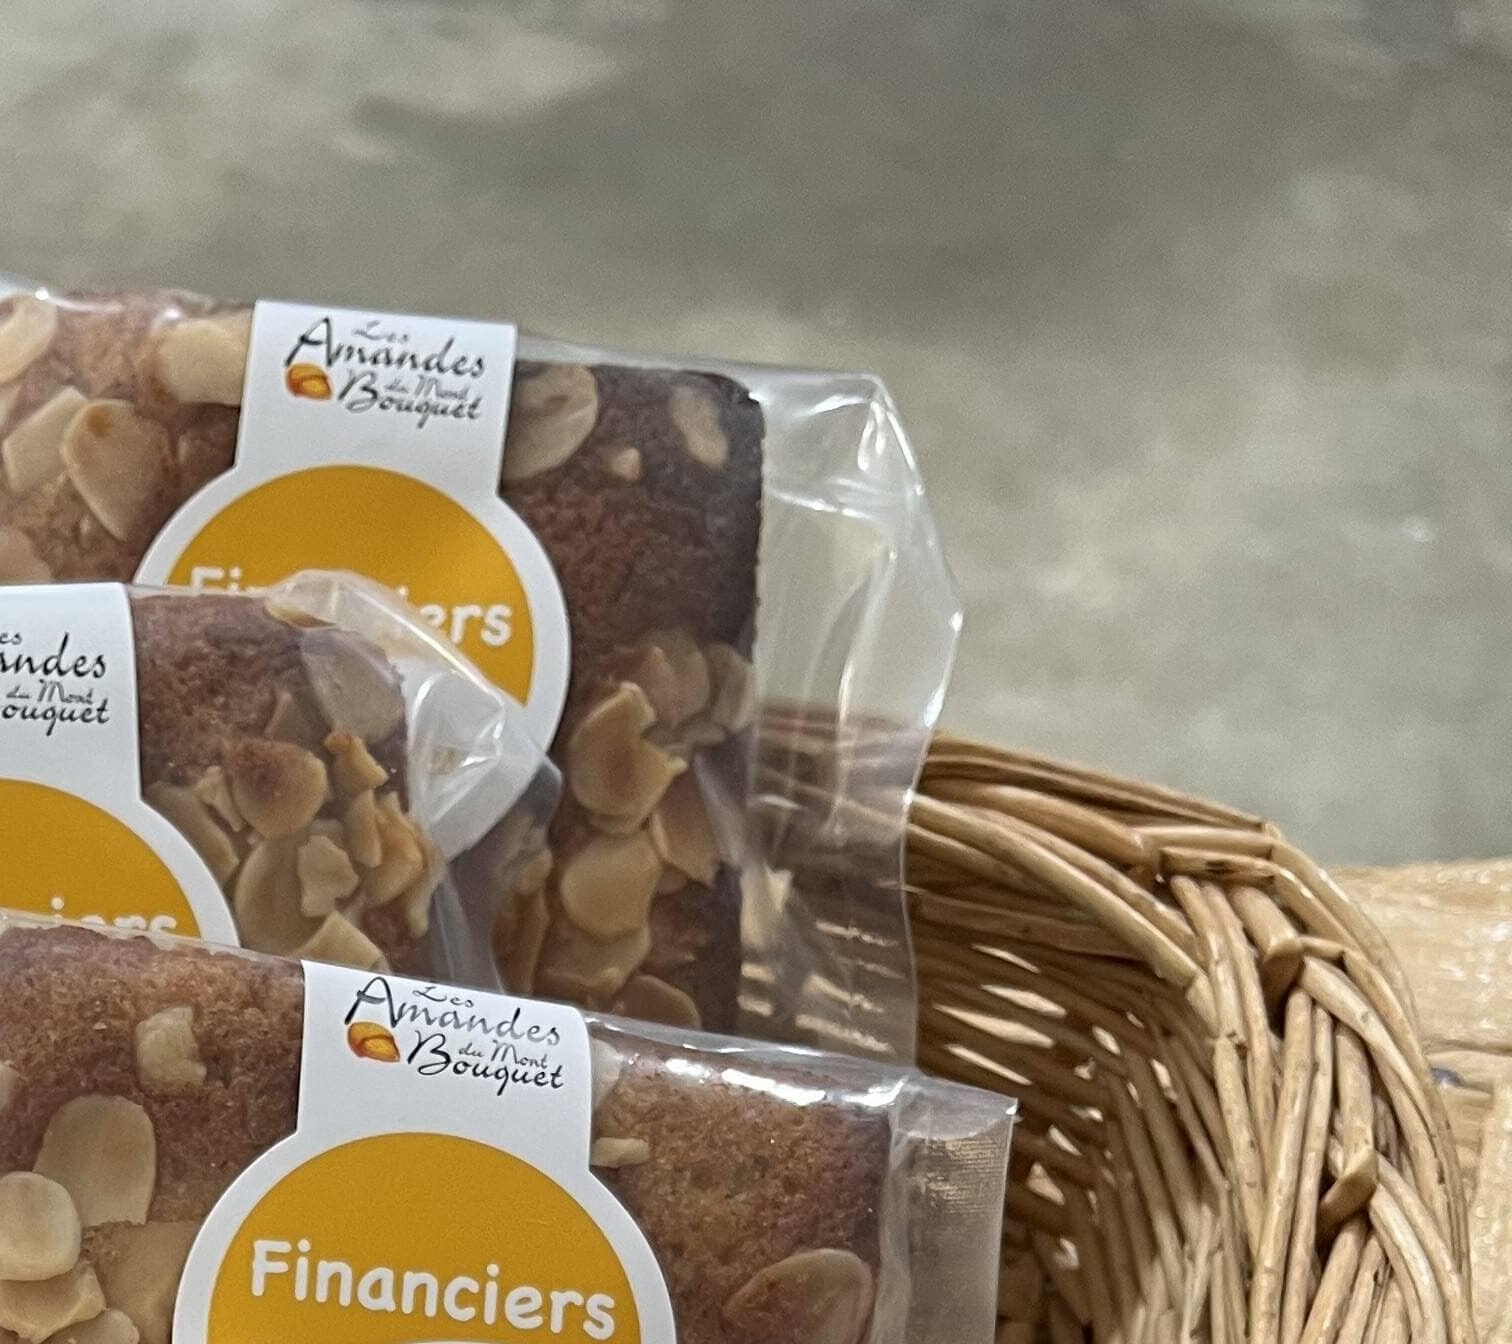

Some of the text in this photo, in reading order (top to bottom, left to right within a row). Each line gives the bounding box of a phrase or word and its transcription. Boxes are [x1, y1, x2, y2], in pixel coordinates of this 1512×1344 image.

[285, 316, 486, 378] Amandes
[337, 369, 483, 430] Bouquet
[344, 976, 561, 1047] Amandes
[411, 985, 475, 1008] Les
[407, 1029, 565, 1097] Bouquet
[458, 1039, 549, 1069] du Mont
[251, 1238, 616, 1341] Financiers
